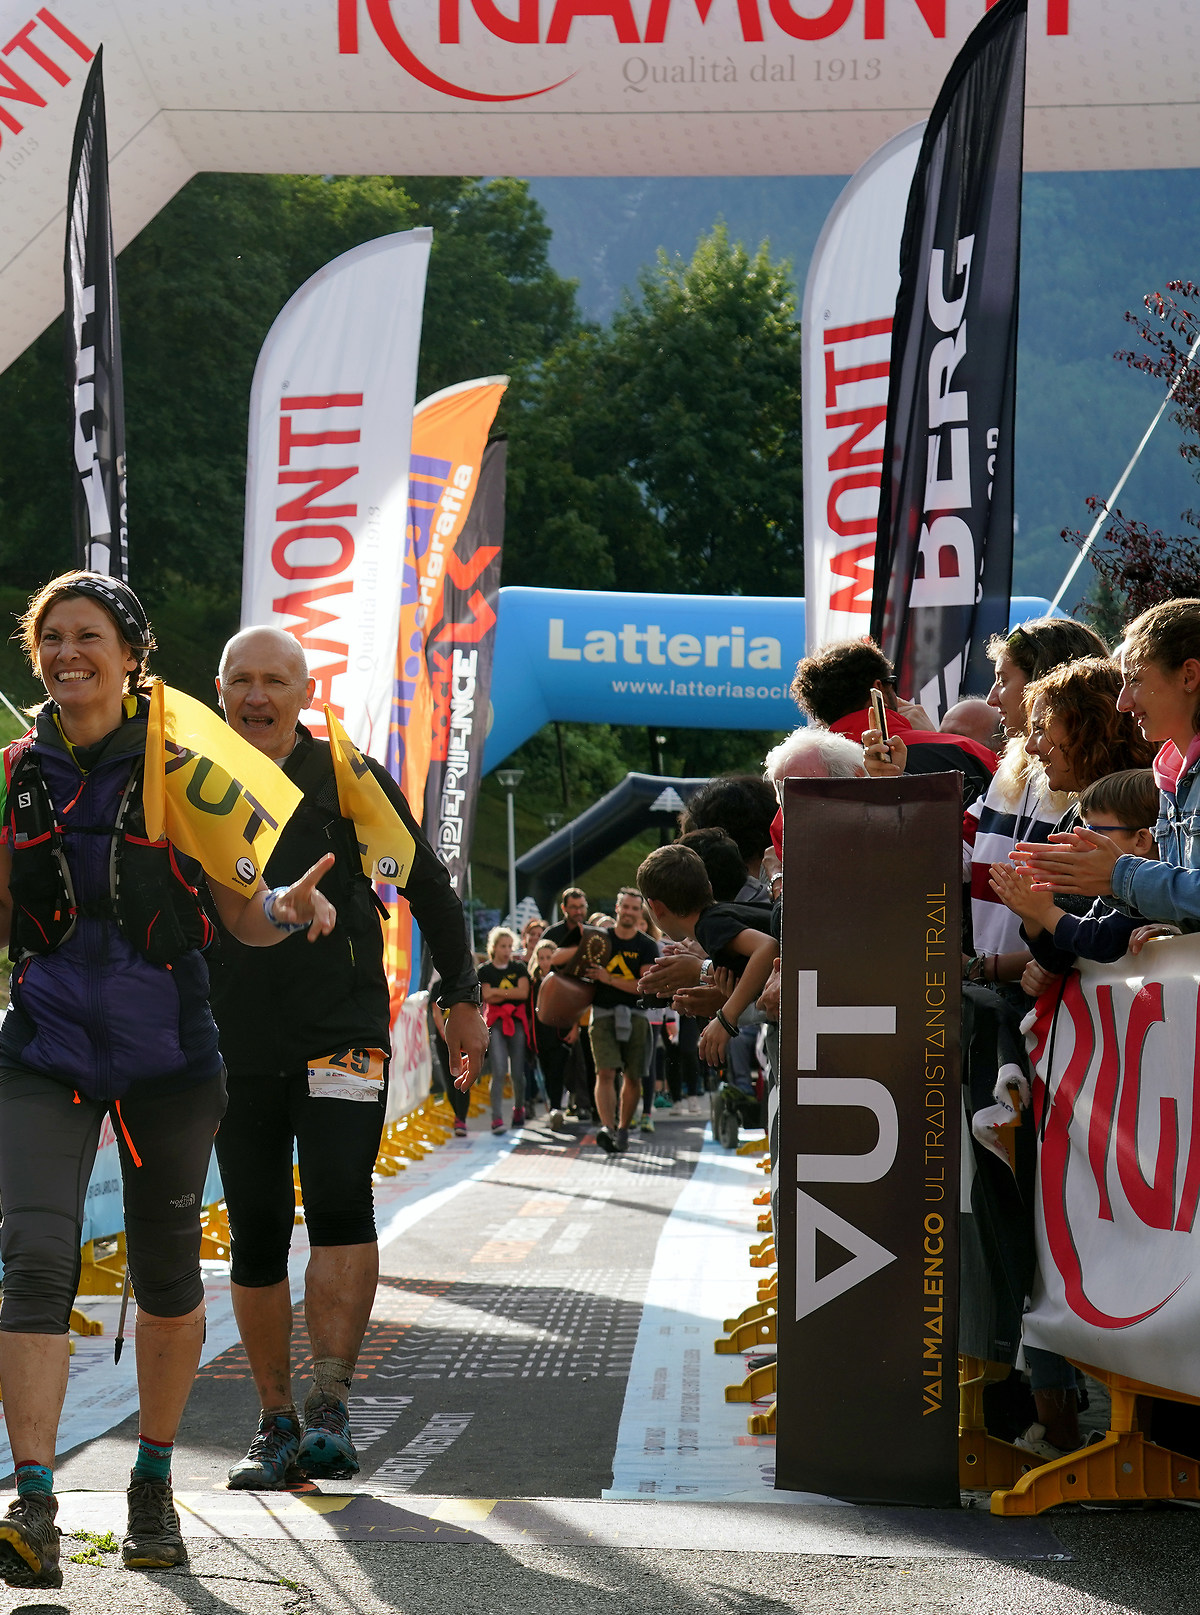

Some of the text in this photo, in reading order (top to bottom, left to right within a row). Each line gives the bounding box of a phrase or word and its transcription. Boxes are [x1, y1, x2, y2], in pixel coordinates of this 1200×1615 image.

[623, 53, 883, 93] Qualità dal 1913
[909, 232, 976, 608] BERG
[417, 464, 473, 628] erigrafia
[430, 649, 454, 762] ROCK
[548, 618, 782, 669] Latteria
[923, 882, 947, 1417] VALMALENCO ULTRADISTANCE TRAIL
[1029, 966, 1200, 1330] RIG
